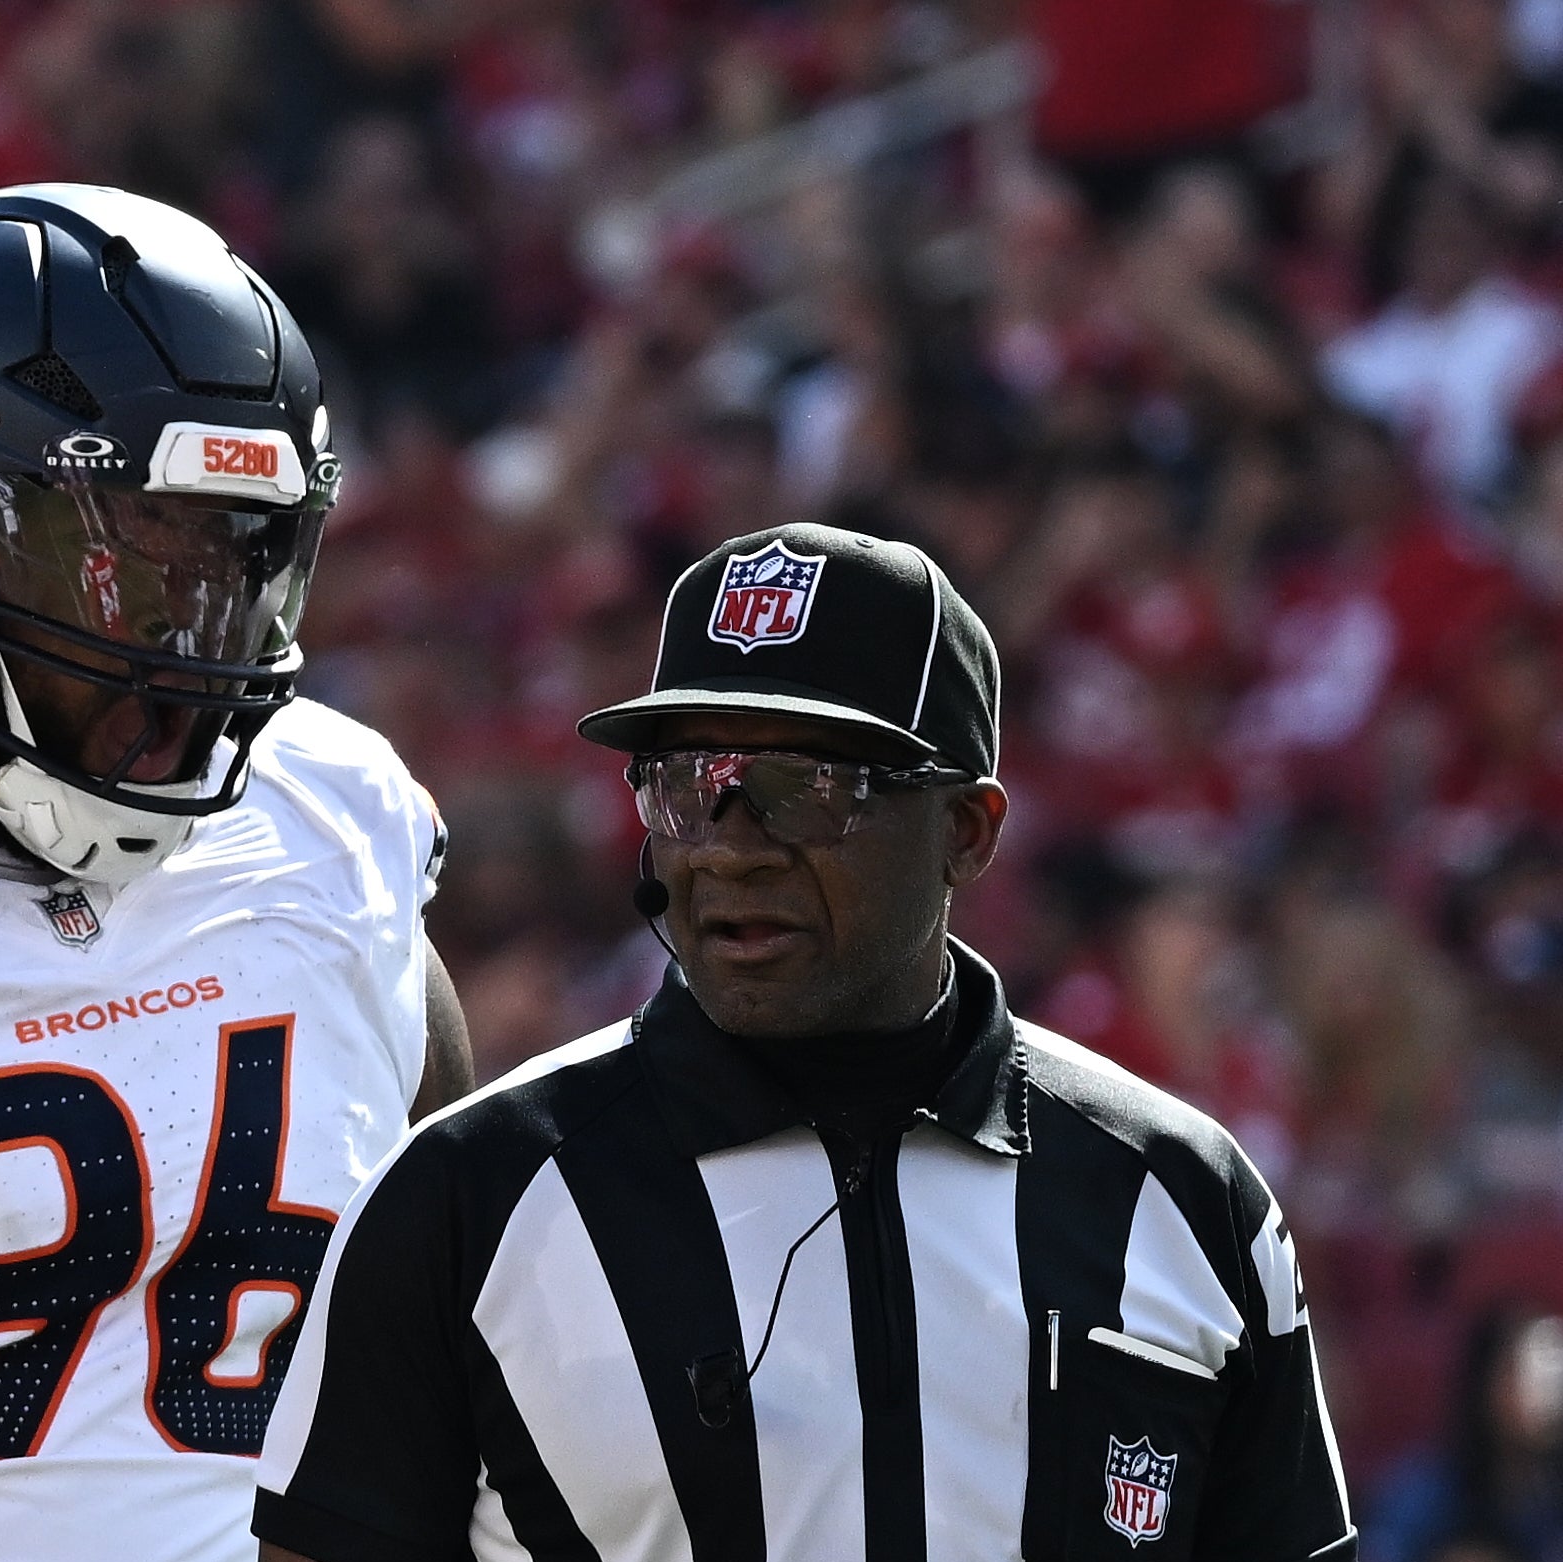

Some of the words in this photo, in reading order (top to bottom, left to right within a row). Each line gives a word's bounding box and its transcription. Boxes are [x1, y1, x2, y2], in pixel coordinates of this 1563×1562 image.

[47, 456, 126, 469] OAKLEY
[203, 437, 278, 478] 5280
[717, 588, 798, 637] NFL
[55, 910, 96, 937] NFL
[15, 975, 225, 1044] BRONCOS
[1110, 1477, 1161, 1532] NFL
